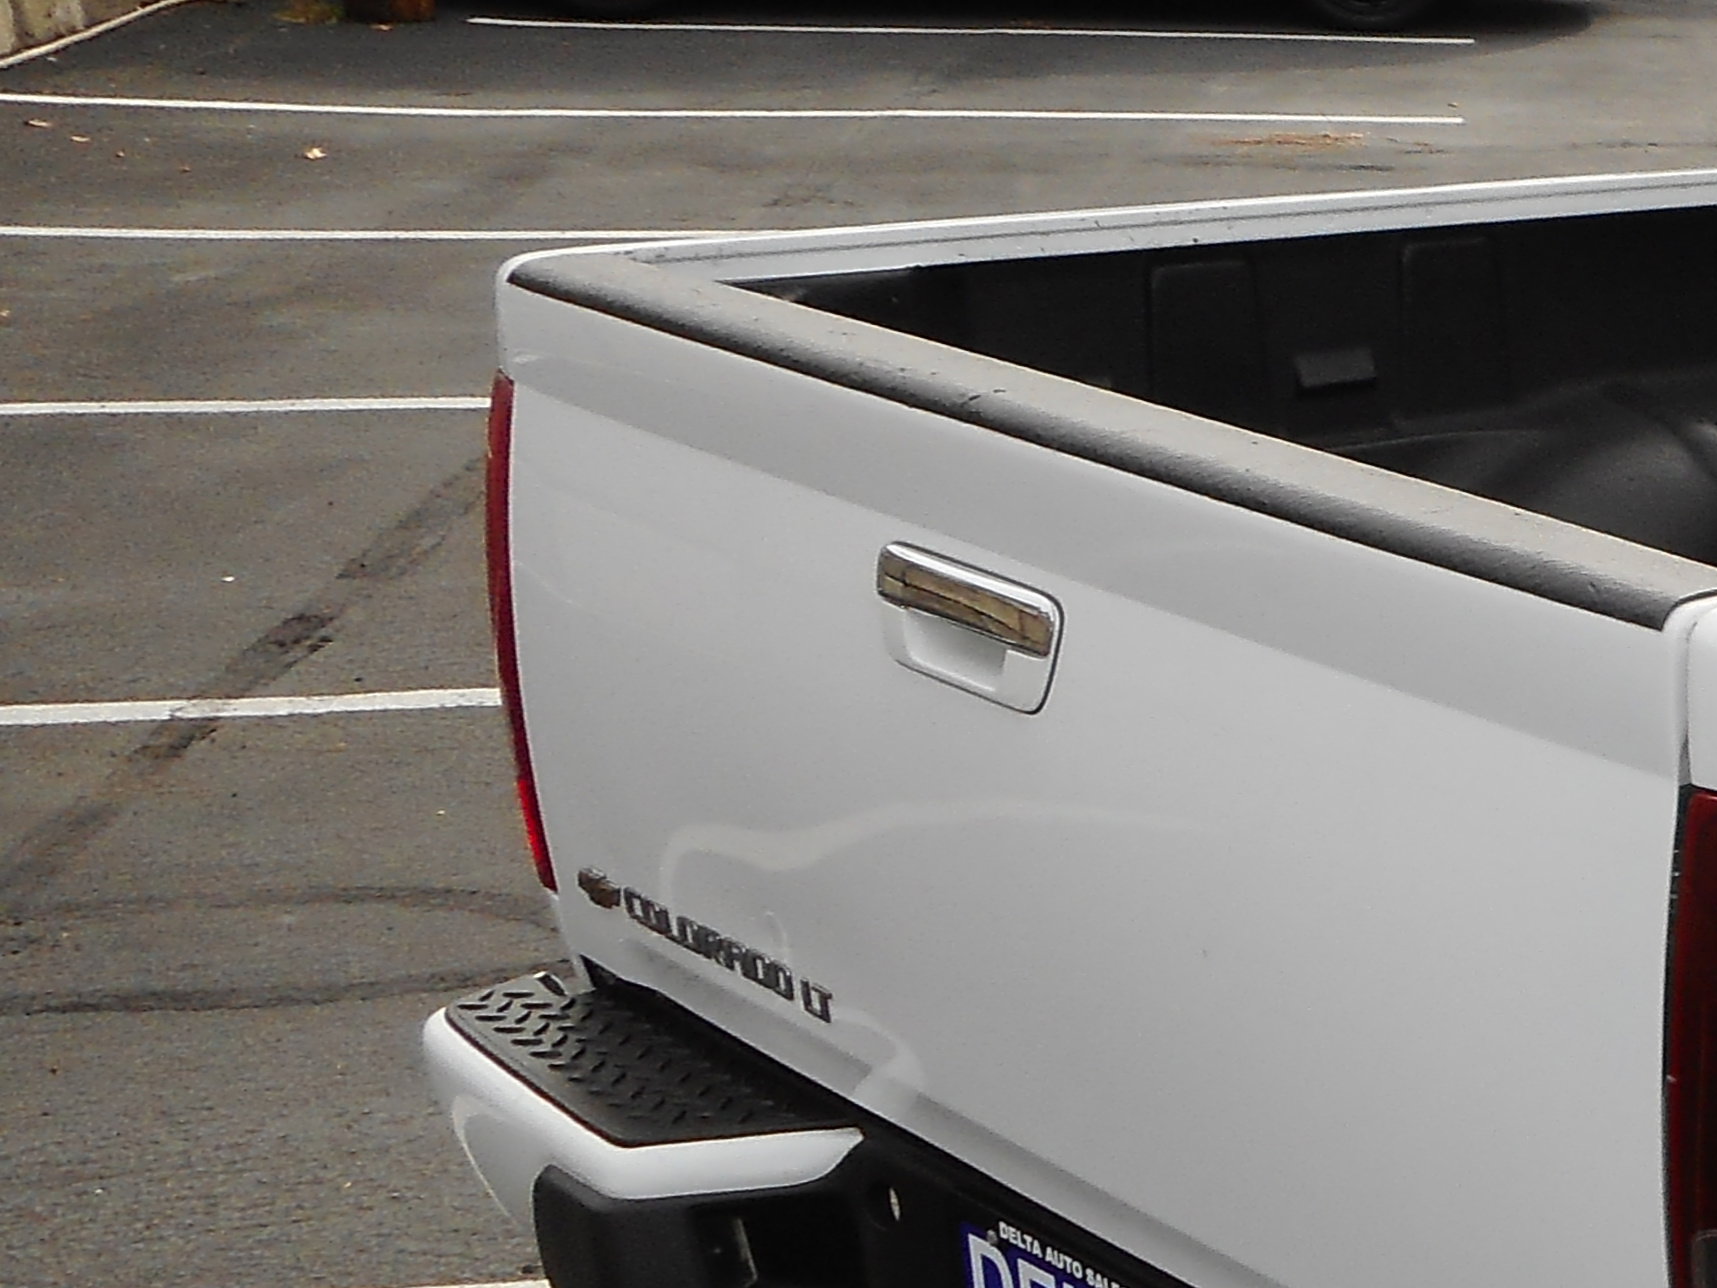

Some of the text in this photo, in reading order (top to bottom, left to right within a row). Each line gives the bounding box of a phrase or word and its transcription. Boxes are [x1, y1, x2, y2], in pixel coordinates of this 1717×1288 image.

[624, 886, 833, 1024] COLORADO LT
[999, 1221, 1042, 1258] DELTA
[1045, 1246, 1083, 1279] AUTO
